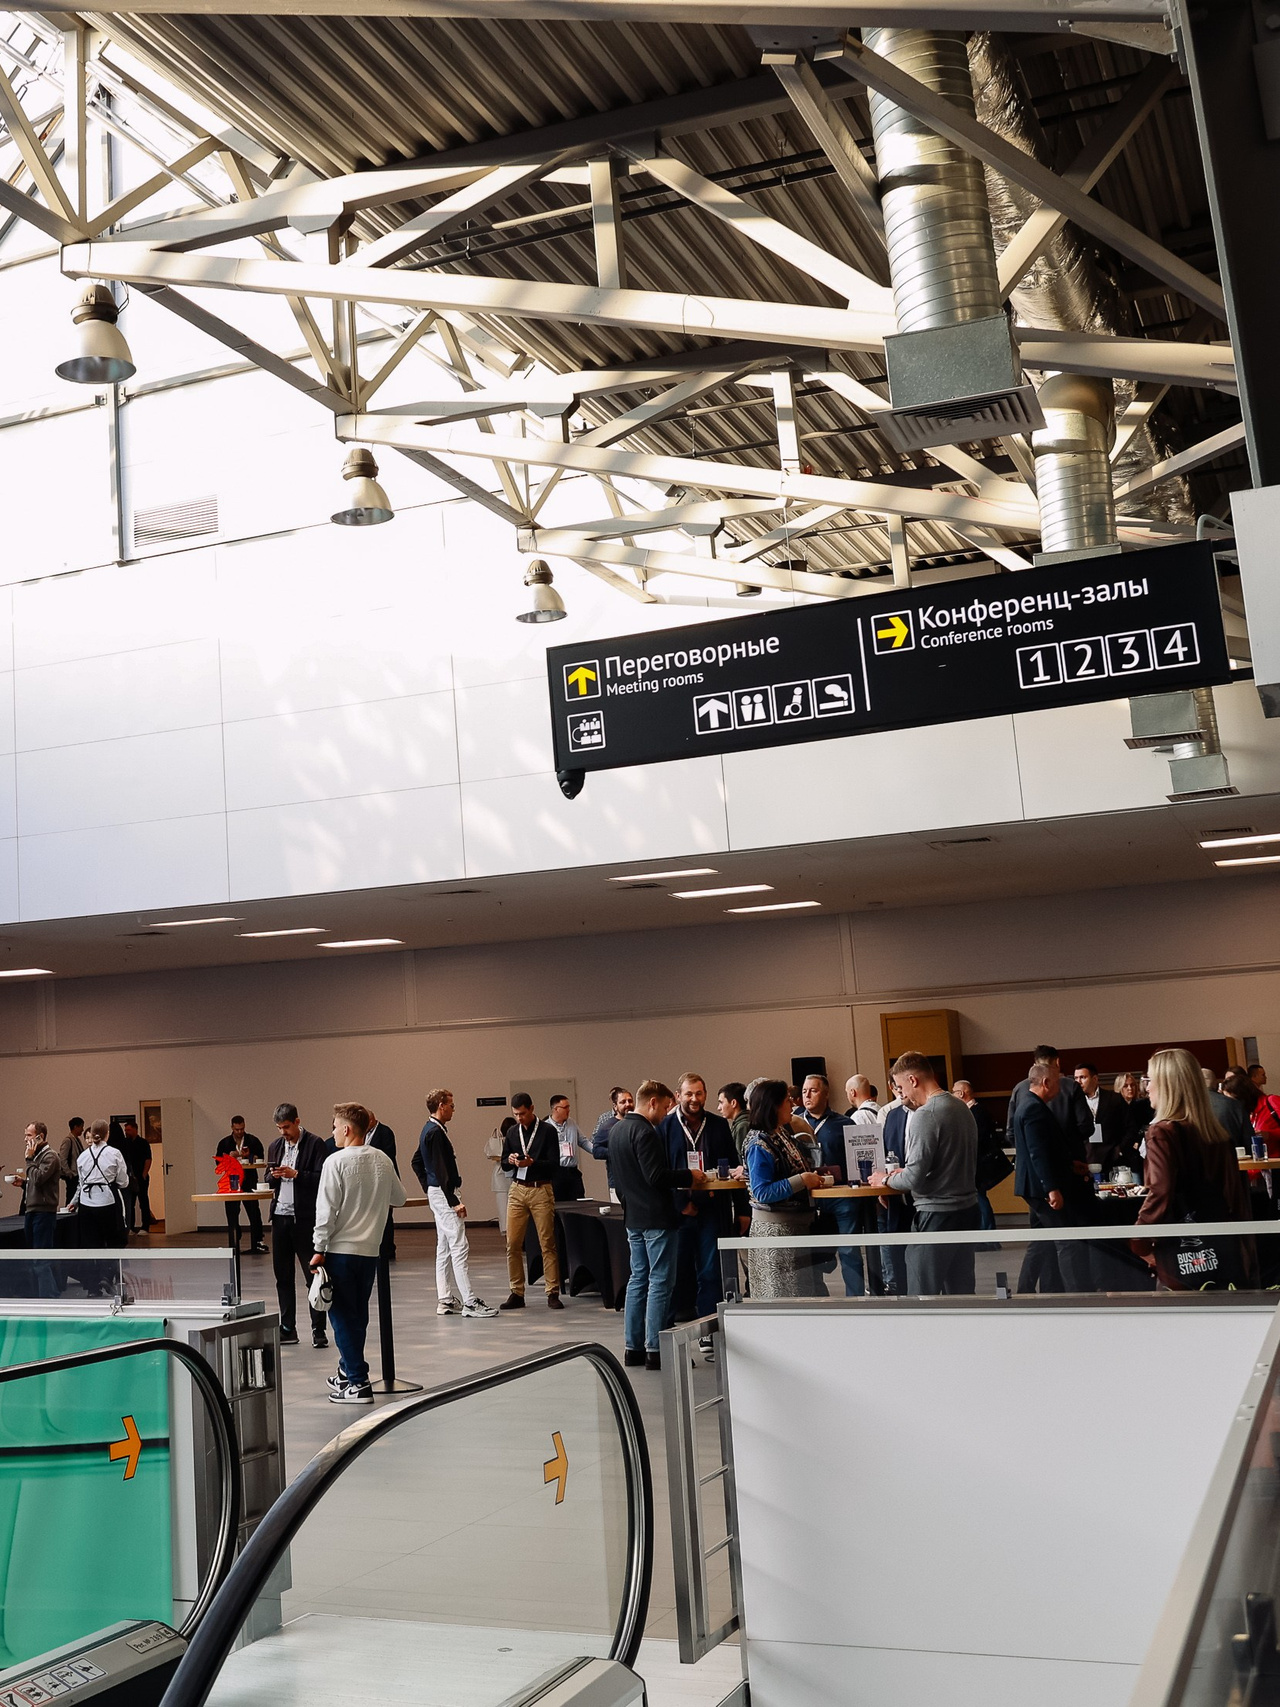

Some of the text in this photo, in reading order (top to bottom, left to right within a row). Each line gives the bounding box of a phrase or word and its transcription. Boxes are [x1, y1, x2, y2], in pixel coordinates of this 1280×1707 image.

[918, 577, 1149, 631] Конференц-залы
[920, 618, 1054, 649] Conference rooms
[605, 636, 780, 679] Переговорные
[1029, 629, 1188, 682] 1 2 3 4
[606, 672, 704, 697] Meeting rooms
[1176, 1248, 1217, 1264] BUSINESS
[1179, 1258, 1219, 1275] STANDUP
